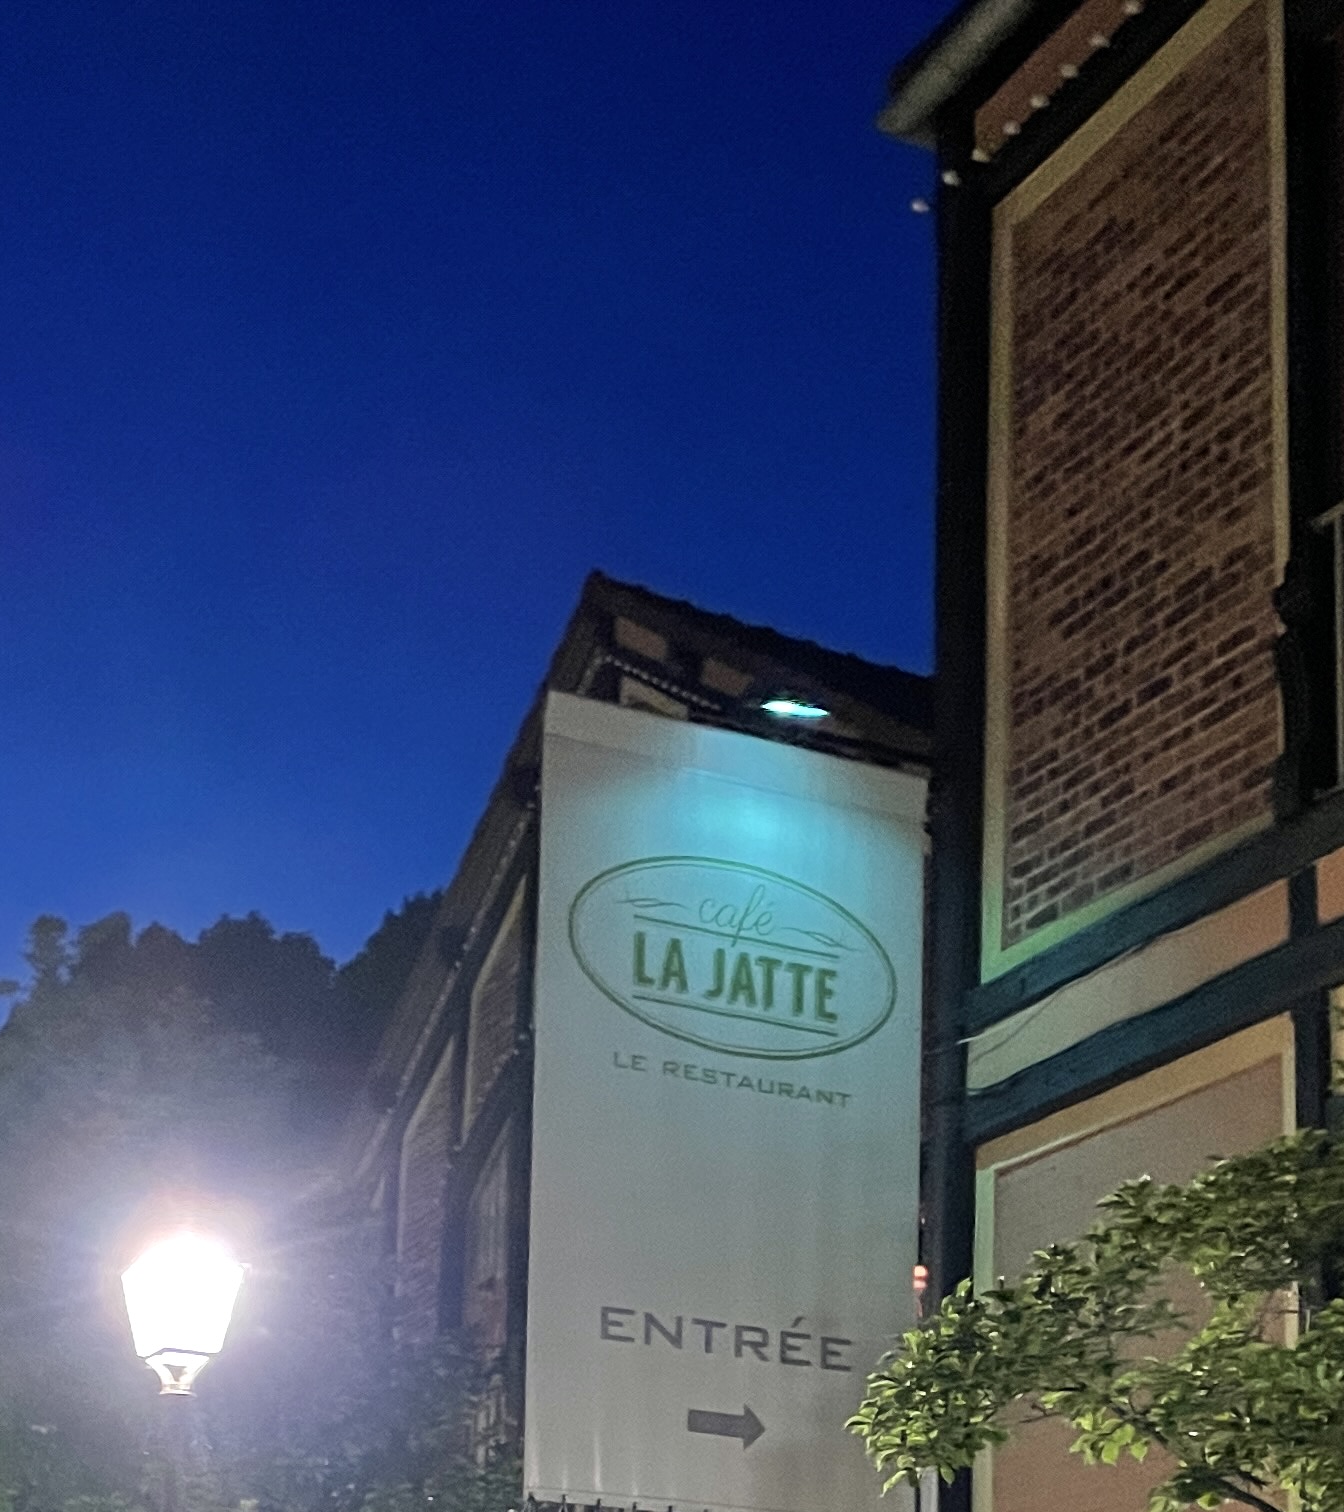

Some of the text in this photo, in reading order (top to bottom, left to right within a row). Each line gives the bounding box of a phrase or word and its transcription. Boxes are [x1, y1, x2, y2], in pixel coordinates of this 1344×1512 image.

[698, 885, 776, 948] café
[632, 931, 840, 1023] LA JATTE
[613, 1051, 851, 1108] LE RESTAURANT
[599, 1305, 853, 1372] ENTRÉE
